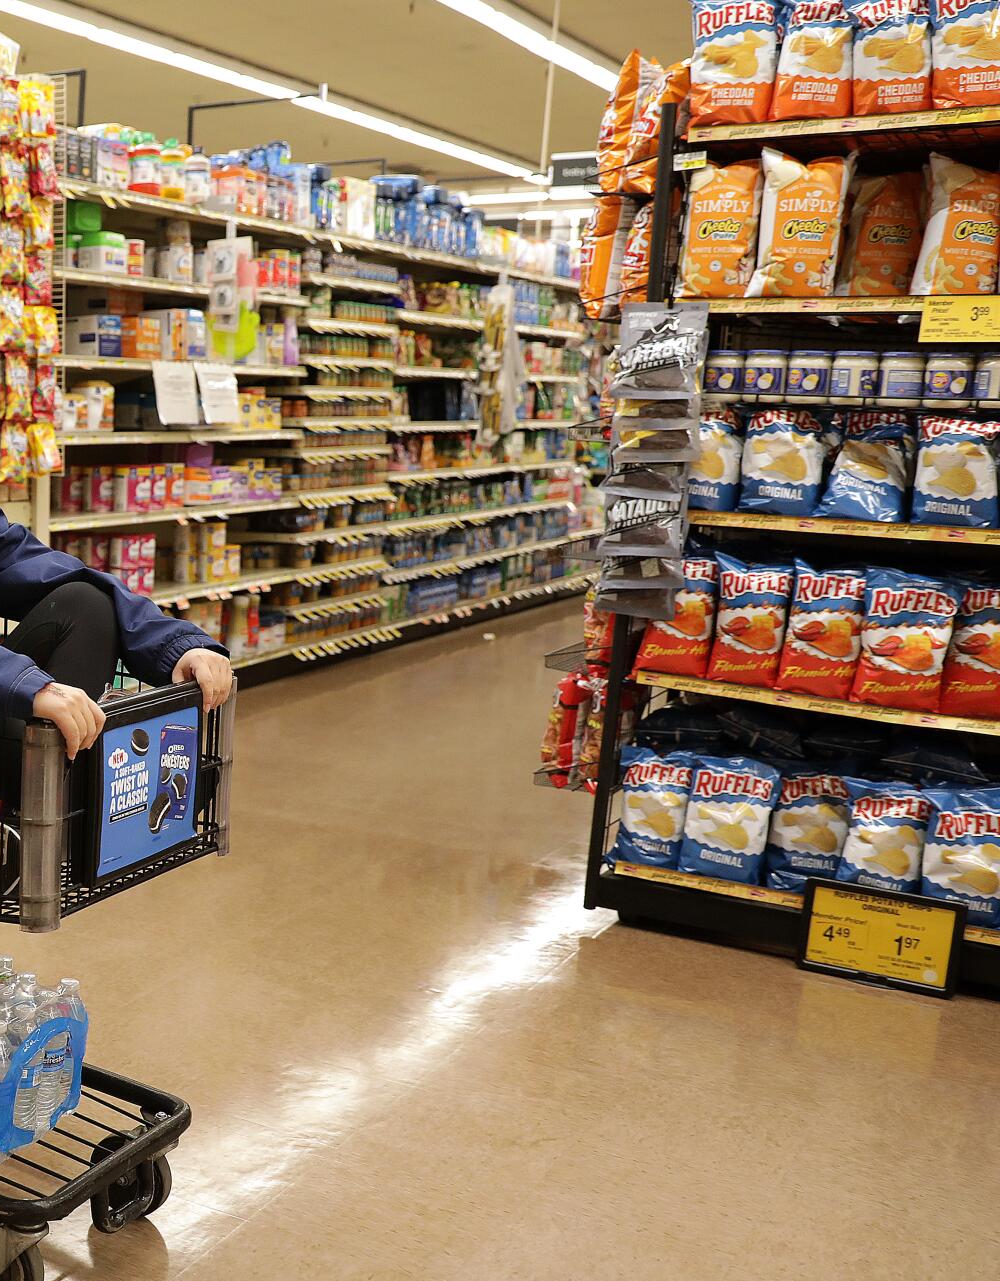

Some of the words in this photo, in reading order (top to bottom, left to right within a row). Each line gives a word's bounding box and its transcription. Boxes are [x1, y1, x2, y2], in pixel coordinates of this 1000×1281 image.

[697, 2, 775, 37] RUFFLES
[712, 88, 755, 99] CHEDDAR
[793, 82, 839, 94] CHEDDAR
[878, 83, 924, 97] CHEDDAR
[694, 199, 750, 213] SIMPLY
[779, 199, 837, 213] SIMPLY
[698, 218, 743, 240] Cheetos
[782, 218, 828, 240] Cheetos
[867, 223, 912, 243] Cheetos
[758, 485, 804, 500] ORIGINAL
[923, 501, 973, 516] ORIGINAL
[721, 571, 795, 599] RUFFLES
[868, 587, 957, 617] RUFFLES
[168, 744, 185, 753] OREO
[112, 752, 124, 765] NEW
[160, 754, 190, 770] CAKESTERS
[111, 775, 136, 797] TWIST
[137, 770, 149, 788] ON
[623, 762, 693, 788] RUFFLES
[694, 770, 773, 800] RUFFLES
[110, 797, 116, 815] A
[117, 787, 149, 811] CLASSIC
[700, 849, 743, 867] ORIGINAL
[791, 856, 836, 871] ORIGINAL
[833, 890, 869, 903] RUFFLES
[871, 896, 906, 908] POTATO
[907, 902, 933, 912] CHIPS
[861, 904, 900, 916] ORIGINAL
